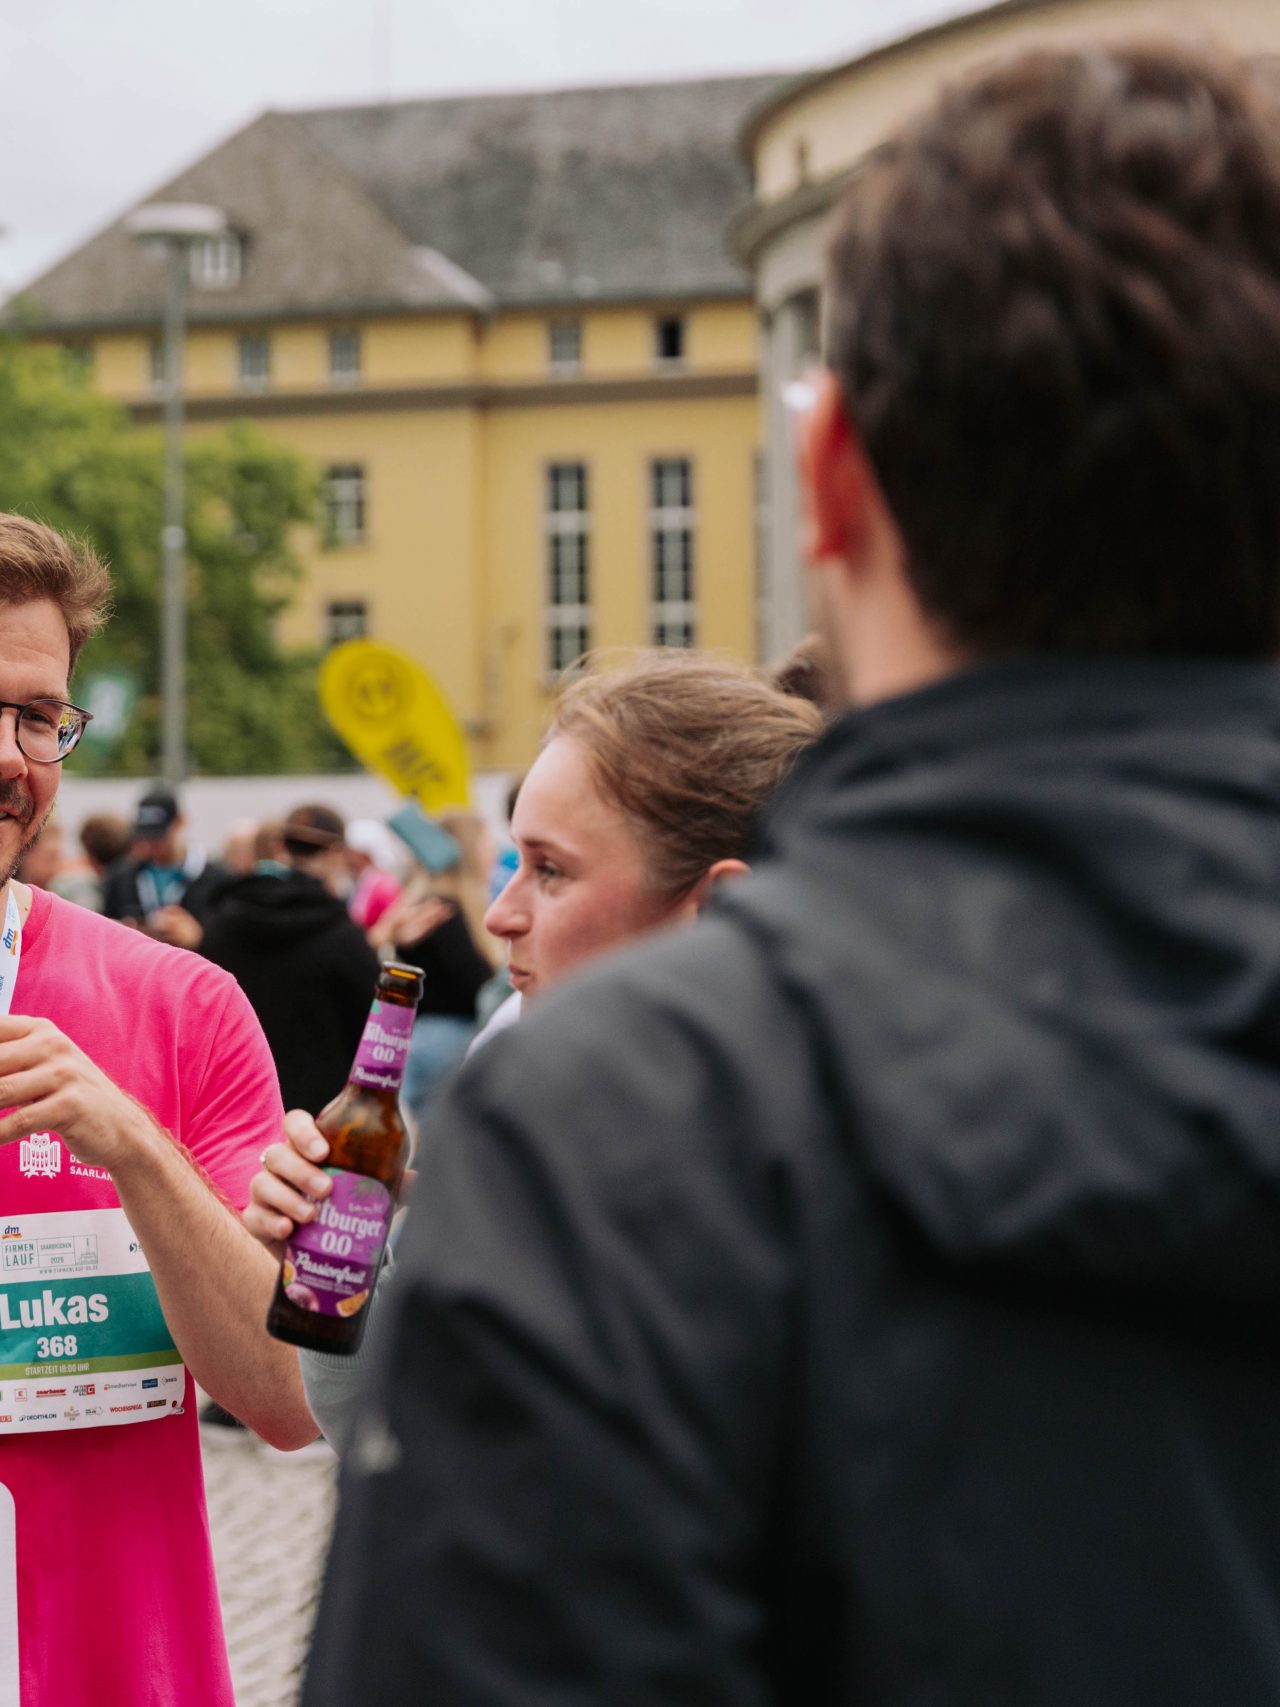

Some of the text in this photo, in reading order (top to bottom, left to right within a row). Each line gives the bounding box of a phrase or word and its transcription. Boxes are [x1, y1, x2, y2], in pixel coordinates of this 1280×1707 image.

[2, 928, 16, 950] dm
[69, 1166, 113, 1181] SAARLAN
[4, 1225, 20, 1235] dm
[4, 1243, 34, 1254] FIRMEN
[5, 1253, 35, 1267] LAUF
[37, 1335, 78, 1358] 368
[25, 1365, 58, 1376] STARTZEIT
[77, 1362, 90, 1372] UHR
